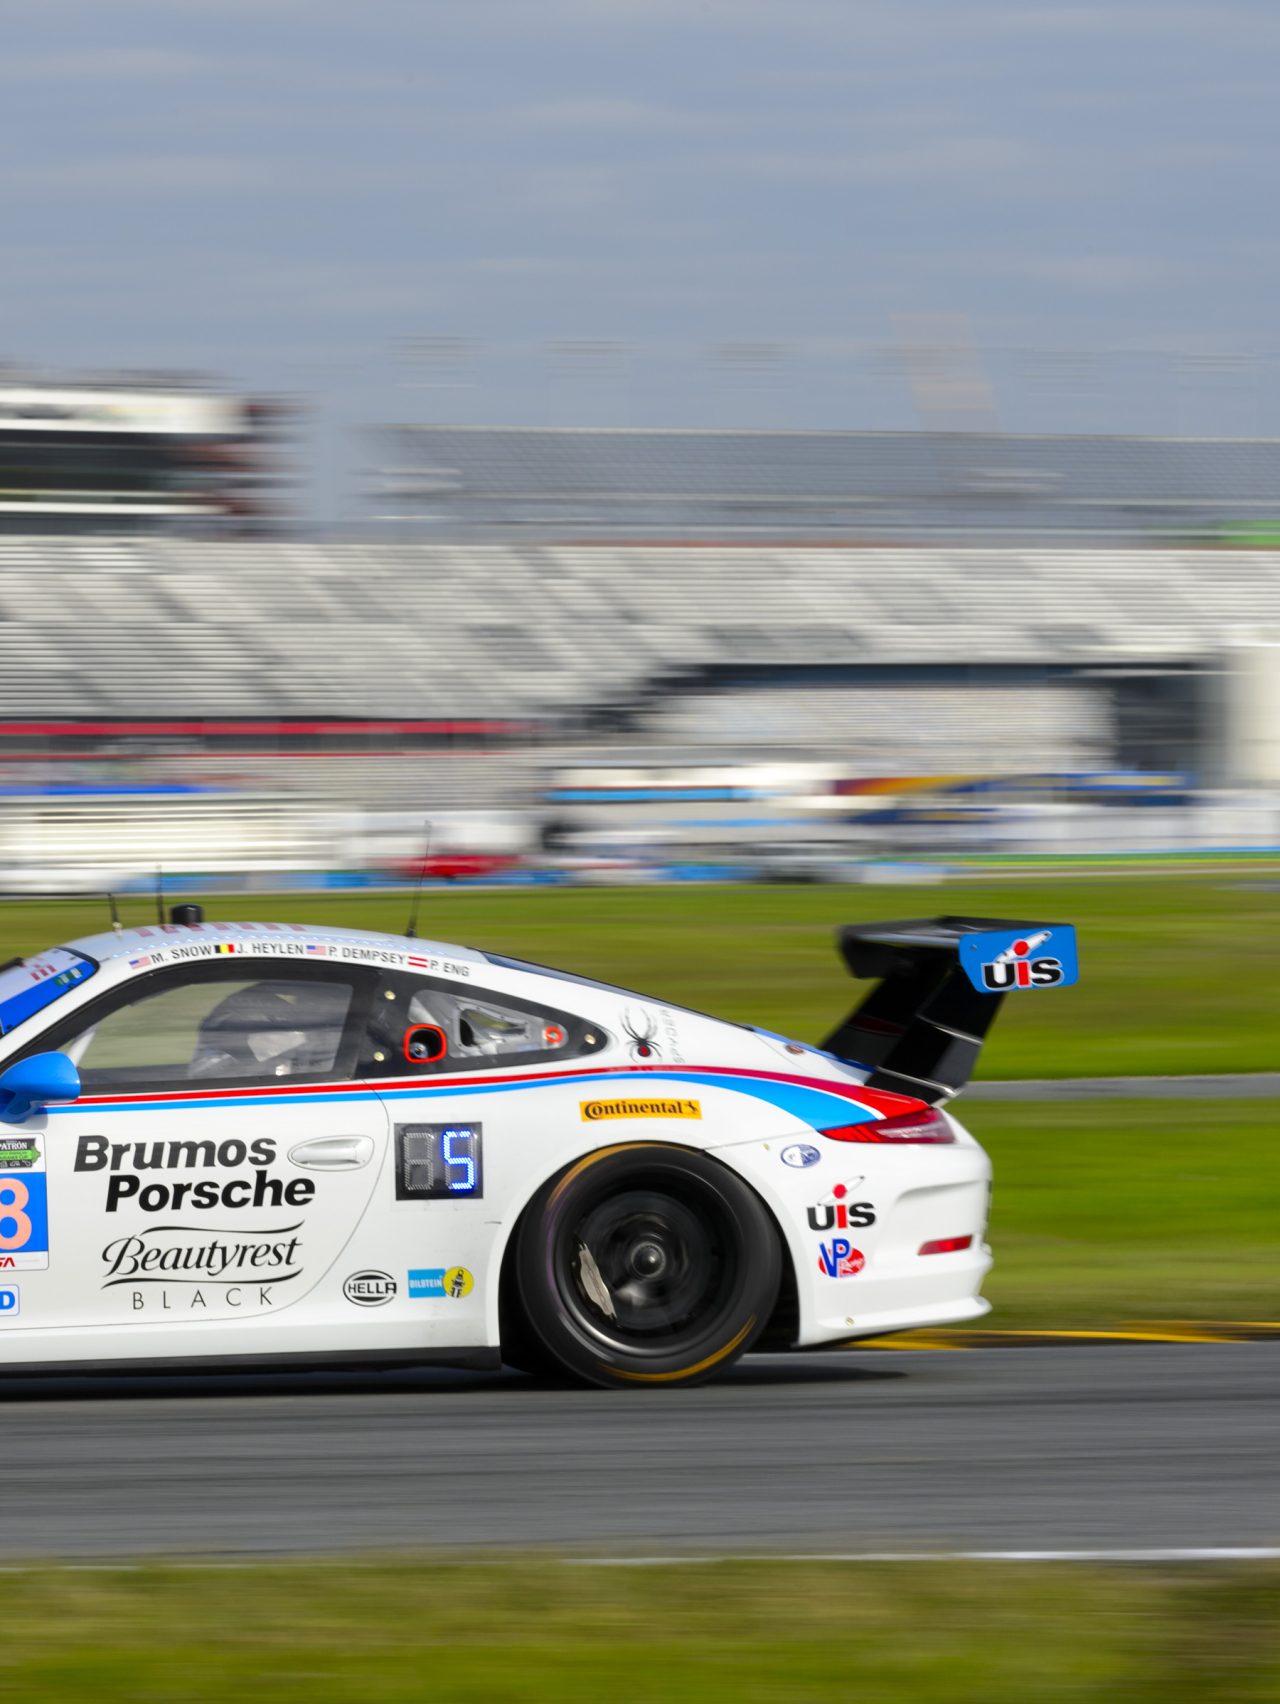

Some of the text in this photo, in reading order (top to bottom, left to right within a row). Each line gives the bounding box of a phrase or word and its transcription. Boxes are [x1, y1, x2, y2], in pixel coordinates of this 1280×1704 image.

[150, 943, 470, 977] M. SNOW J. HEYLEN P. DEMPSEY P. ENG
[584, 1101, 683, 1120] Continental
[73, 1135, 276, 1173] Brumos
[105, 1170, 316, 1213] Porsche
[101, 1234, 303, 1279] Beautyrest
[132, 1286, 273, 1310] BLACK
[347, 1281, 398, 1294] HELLA
